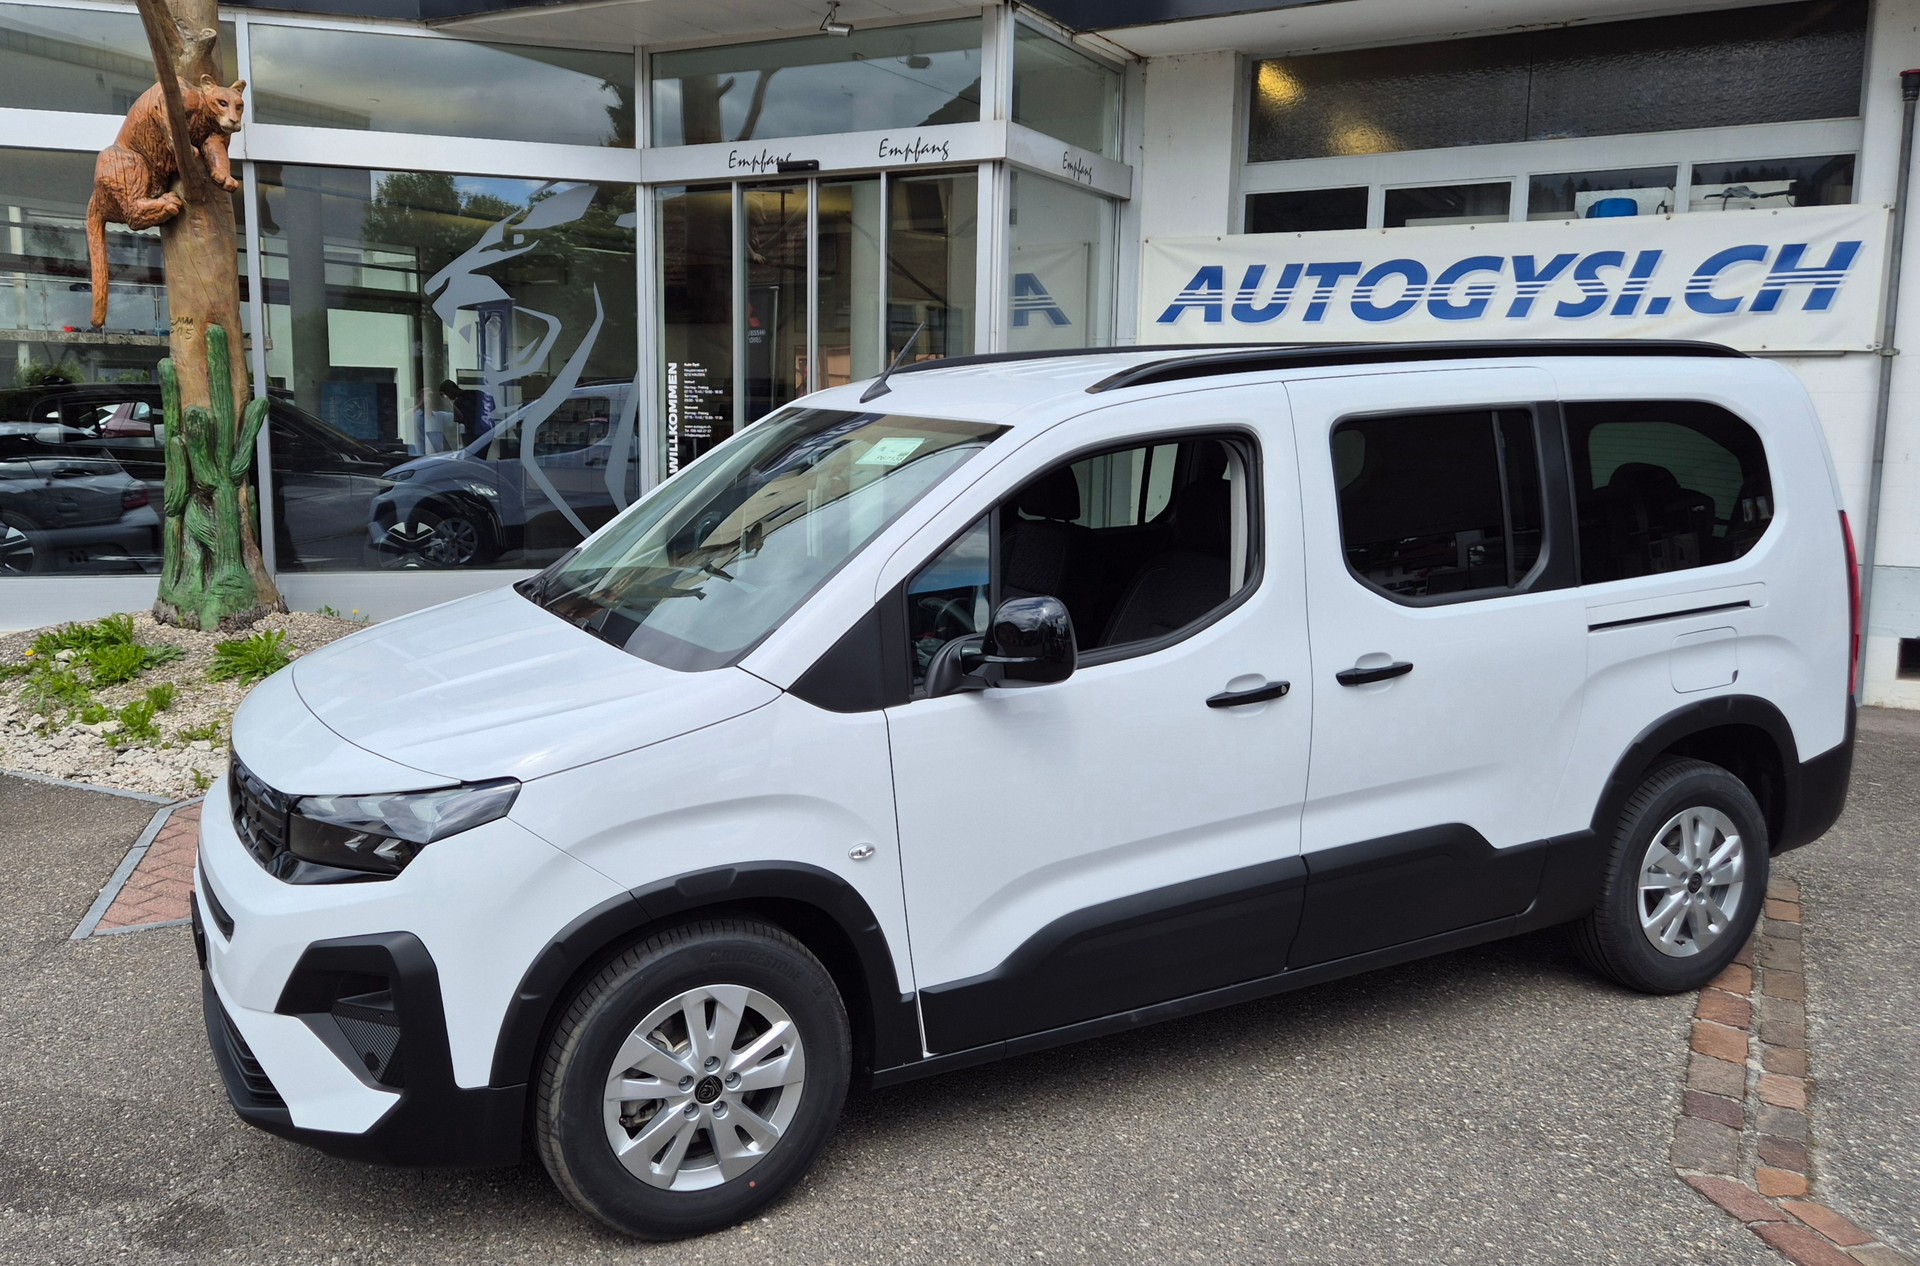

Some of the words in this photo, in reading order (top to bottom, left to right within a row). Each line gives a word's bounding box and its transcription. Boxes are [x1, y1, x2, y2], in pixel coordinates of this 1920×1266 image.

[878, 136, 950, 162] Empfang
[1062, 151, 1093, 185] Empfang
[1156, 240, 1864, 325] AUTOGYSI.CH
[668, 362, 679, 474] WILLKOMMEN
